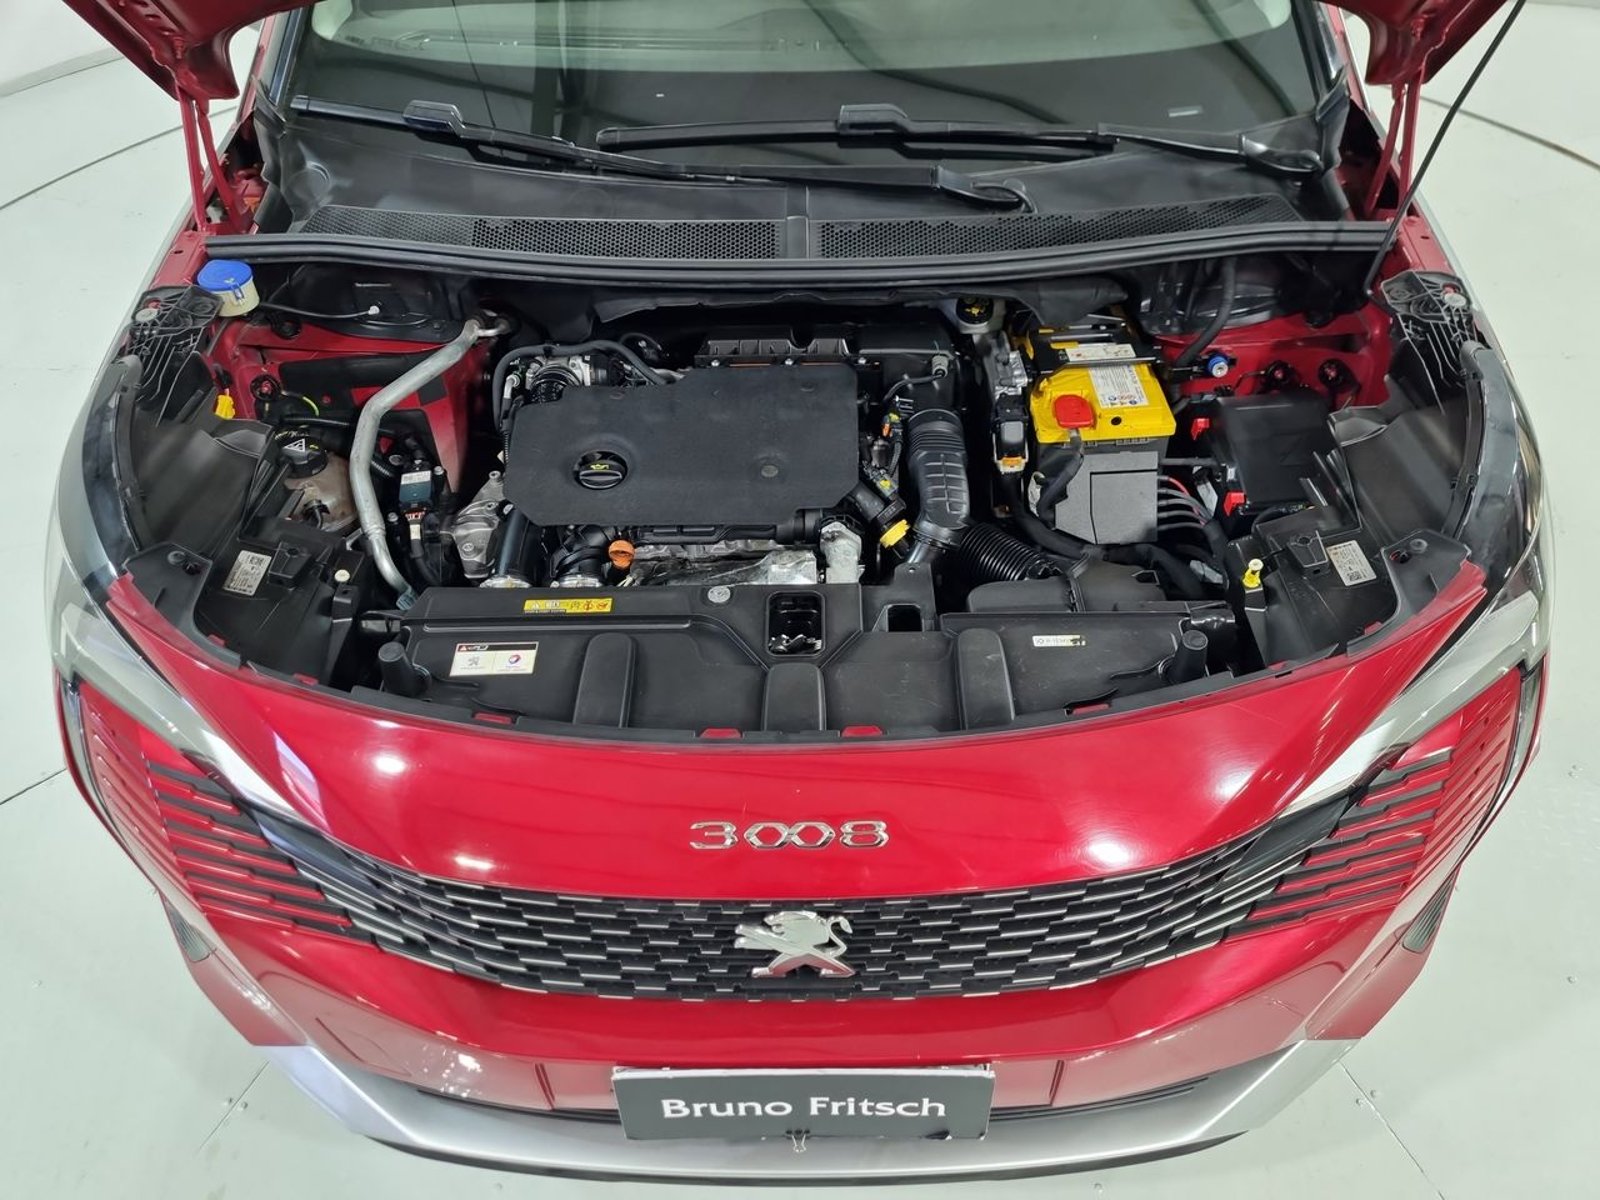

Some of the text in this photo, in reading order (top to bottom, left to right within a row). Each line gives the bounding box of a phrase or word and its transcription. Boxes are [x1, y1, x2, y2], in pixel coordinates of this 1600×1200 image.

[690, 820, 891, 850] 3008
[661, 1096, 946, 1119] Bruno Fritsch
